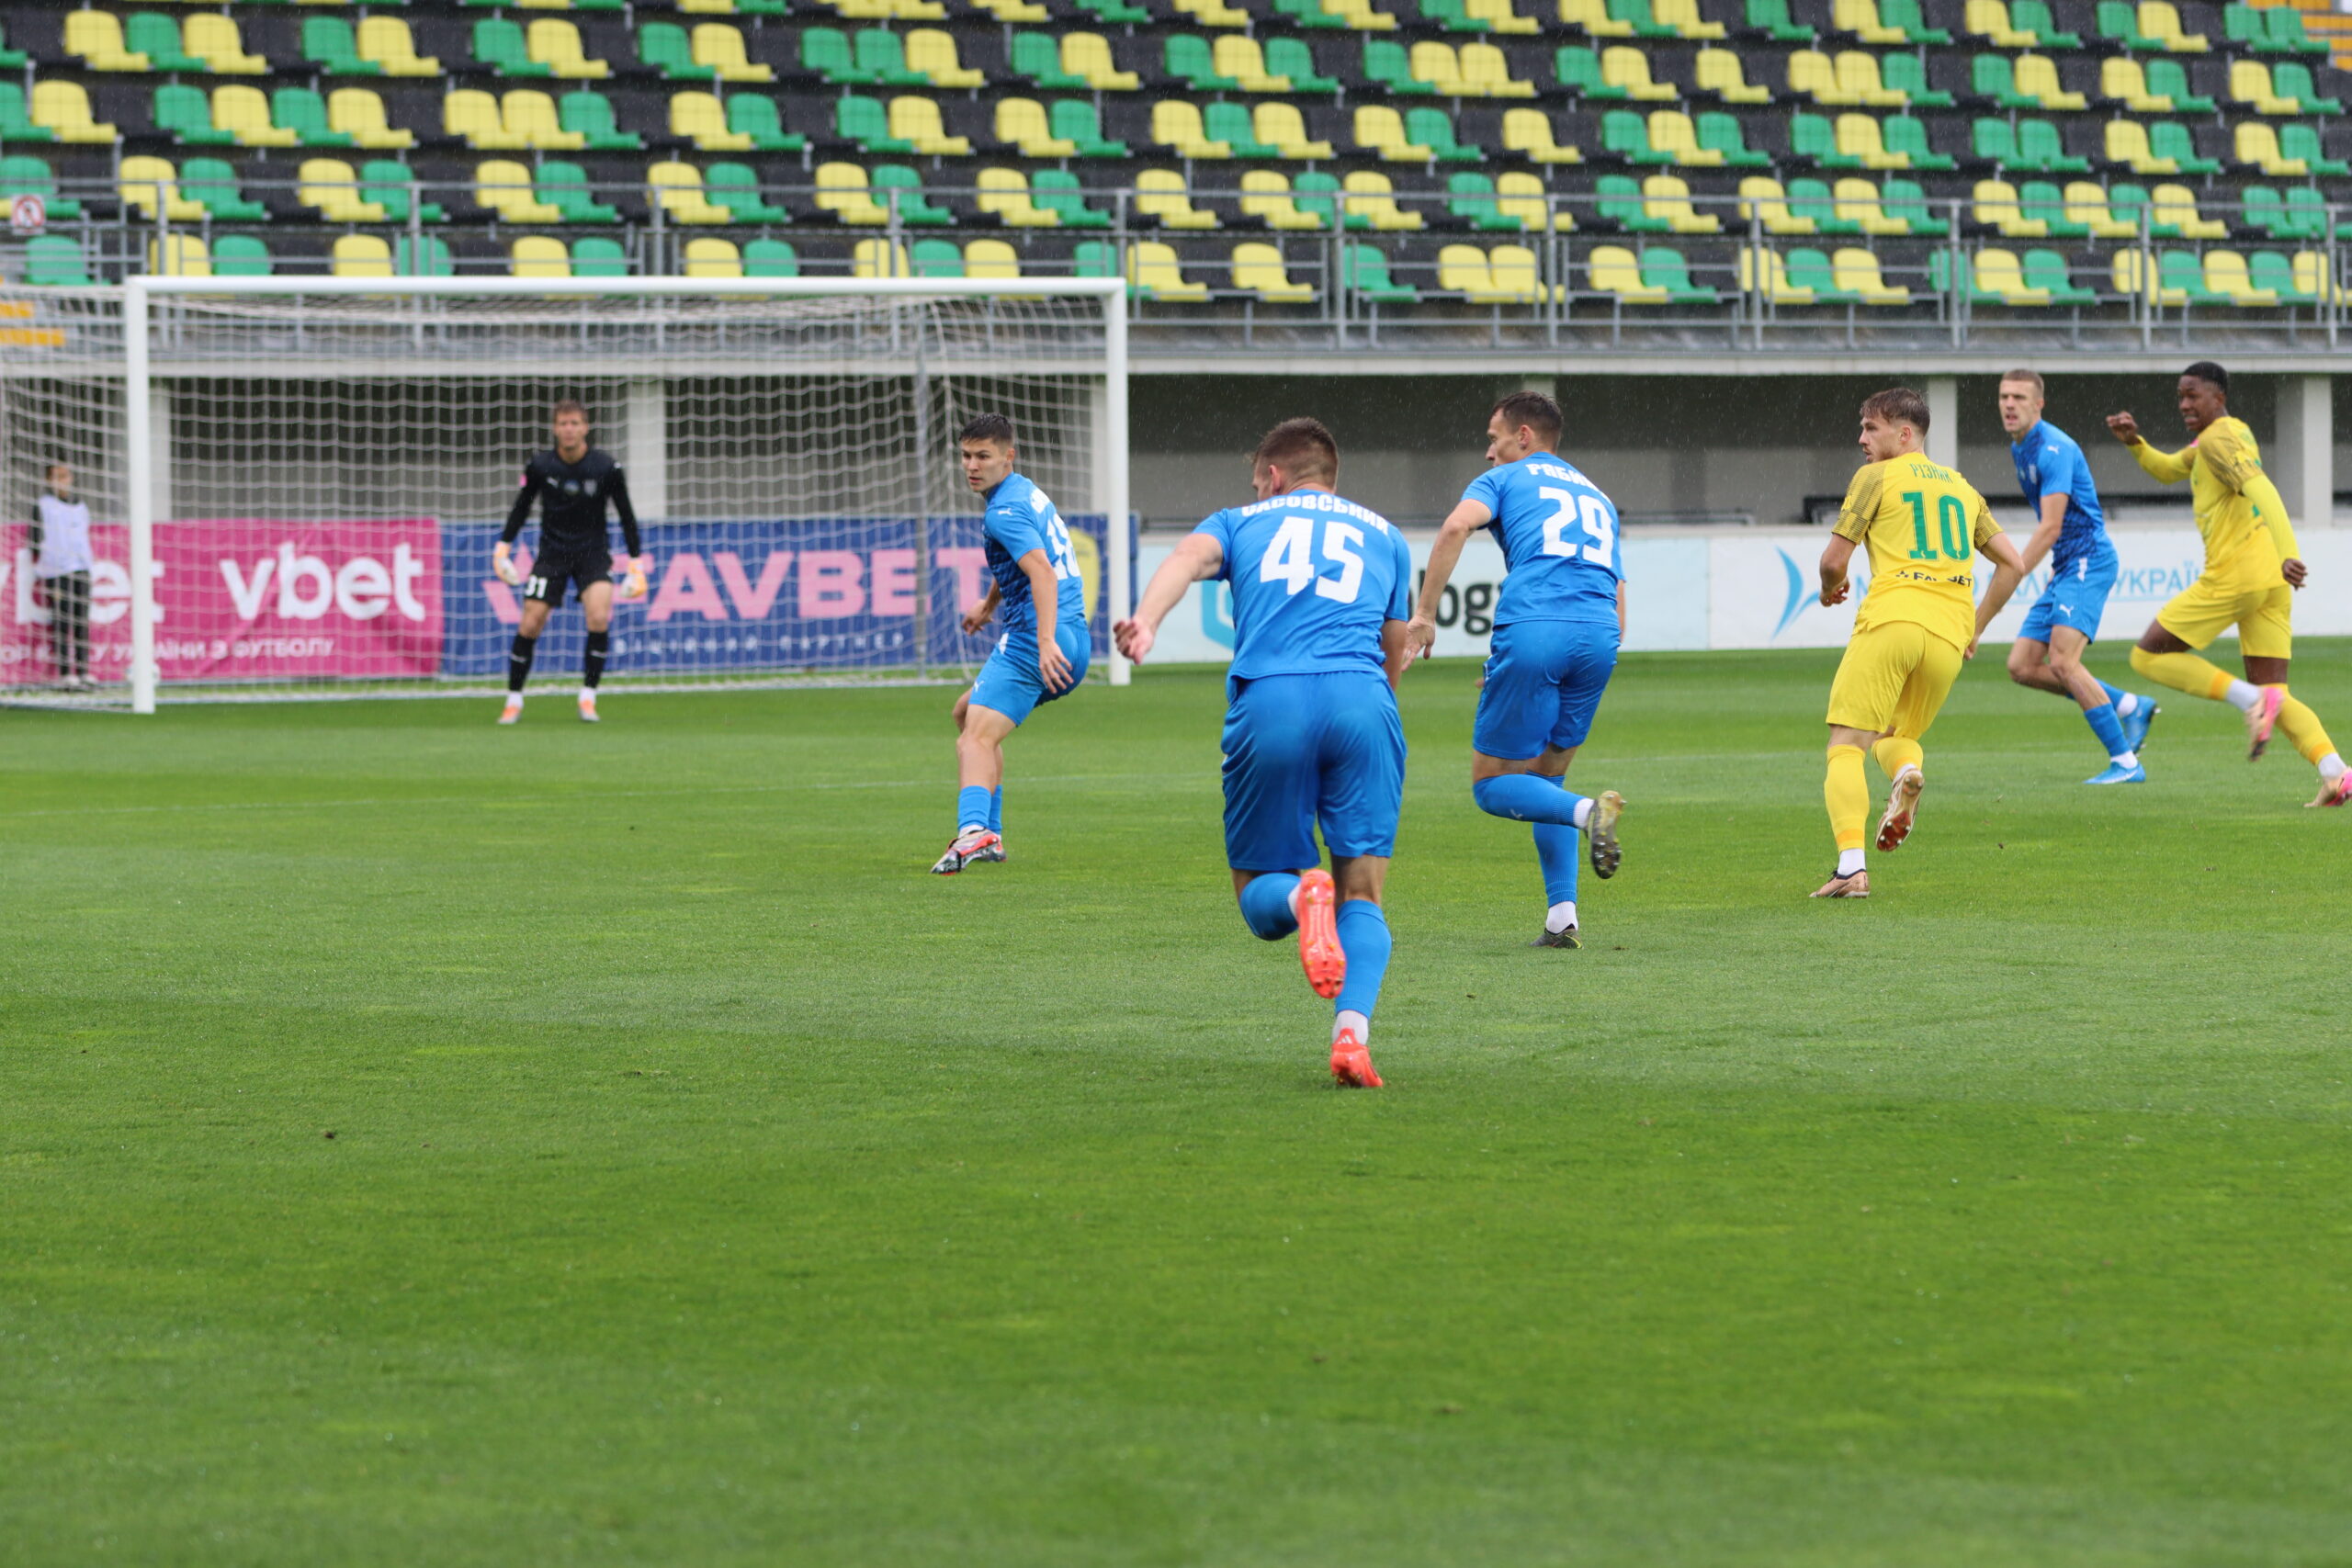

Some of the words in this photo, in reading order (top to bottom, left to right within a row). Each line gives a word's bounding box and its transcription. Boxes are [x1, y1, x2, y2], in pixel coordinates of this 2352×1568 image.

[1260, 515, 1365, 604] 45
[1539, 486, 1614, 568] 29
[1901, 491, 1971, 561] 10
[220, 542, 425, 622] vbet
[526, 574, 548, 599] 31
